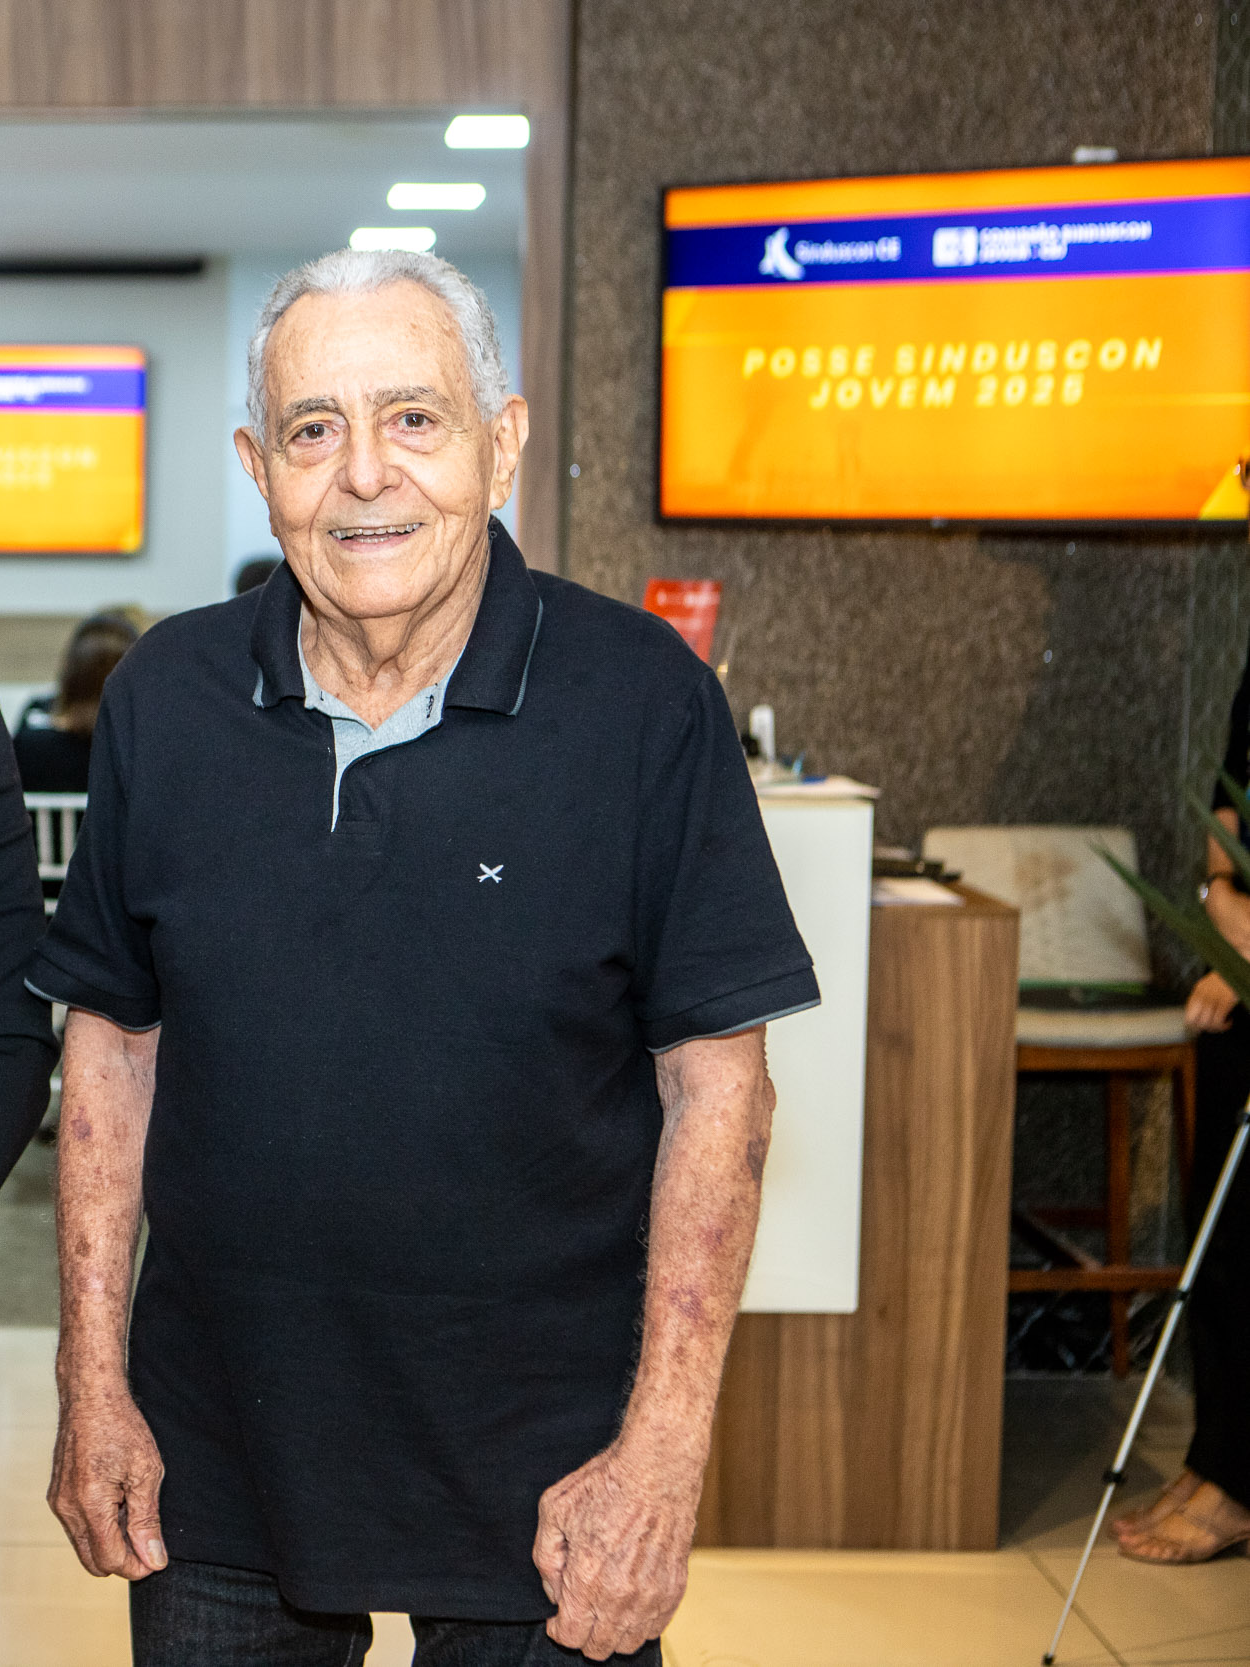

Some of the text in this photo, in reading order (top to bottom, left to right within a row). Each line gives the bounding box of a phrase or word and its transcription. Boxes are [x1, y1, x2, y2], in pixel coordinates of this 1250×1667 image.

[742, 336, 1163, 379] POSSE SINDUSCON
[808, 371, 1085, 411] JOVEM 2025
